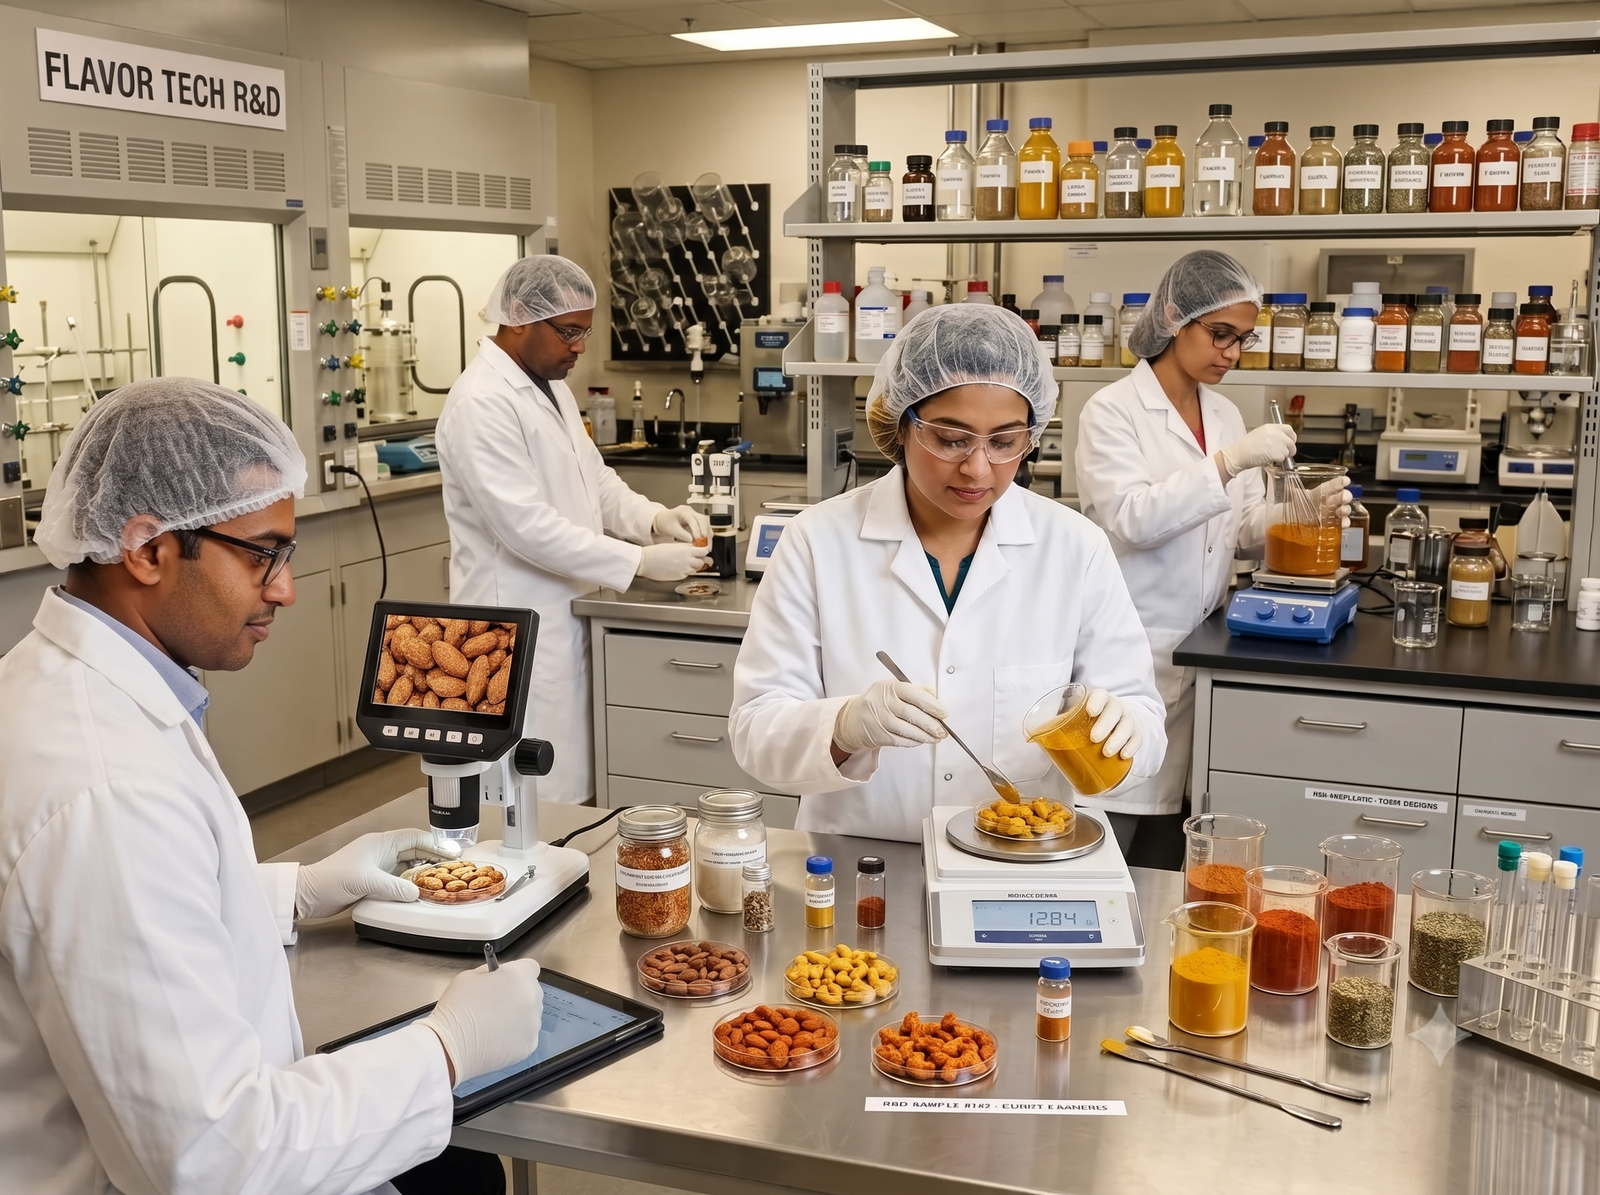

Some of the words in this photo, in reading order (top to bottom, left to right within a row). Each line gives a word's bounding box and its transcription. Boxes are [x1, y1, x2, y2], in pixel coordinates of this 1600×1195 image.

[44, 50, 154, 101] FLAVOR
[161, 69, 225, 110] TECH
[233, 80, 281, 117] R&D
[1030, 911, 1077, 926] 12.84
